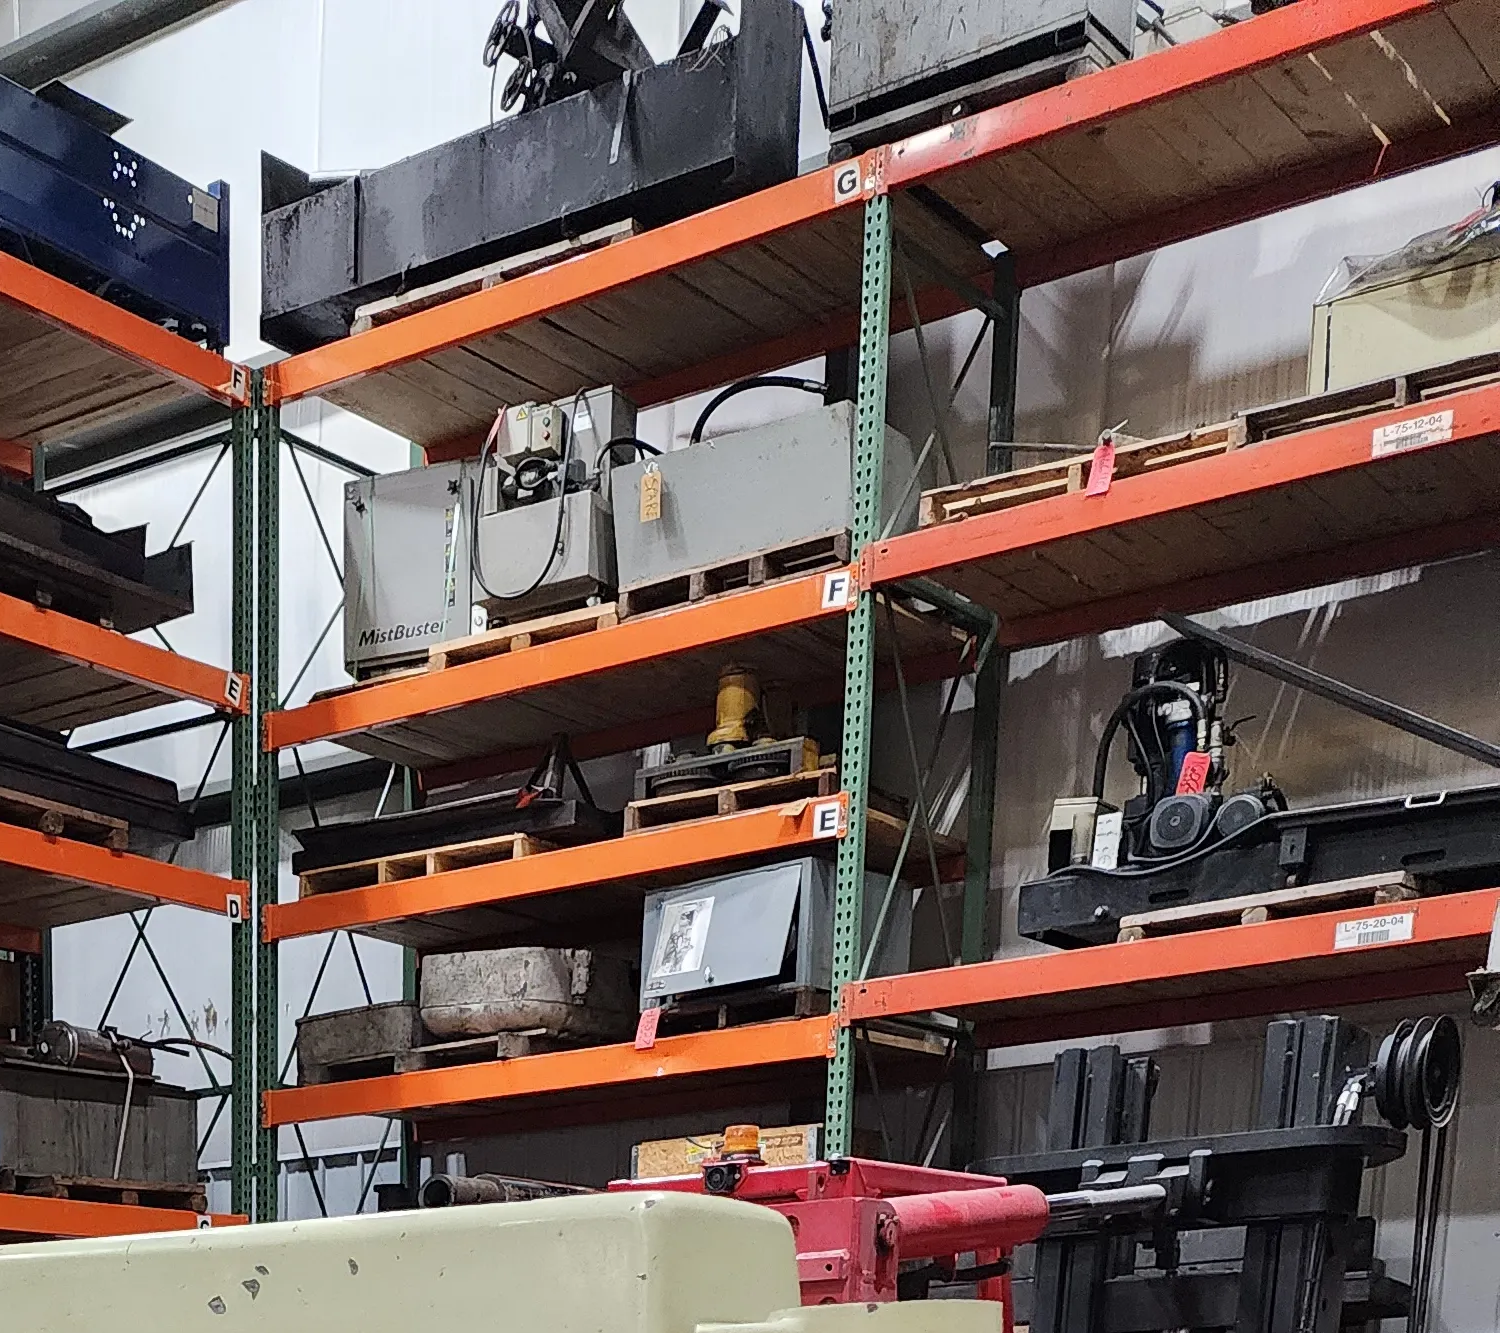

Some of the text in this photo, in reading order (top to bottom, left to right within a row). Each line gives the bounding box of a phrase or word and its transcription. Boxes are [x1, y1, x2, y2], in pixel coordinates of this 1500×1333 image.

[838, 169, 856, 194] G
[233, 369, 243, 389] F
[1383, 415, 1443, 437] L-75-12-04
[828, 577, 846, 602] F
[359, 619, 448, 647] MistBuster
[228, 677, 239, 701] E
[820, 808, 836, 832] E
[230, 900, 239, 918] D
[1344, 916, 1404, 932] L-75-20-04
